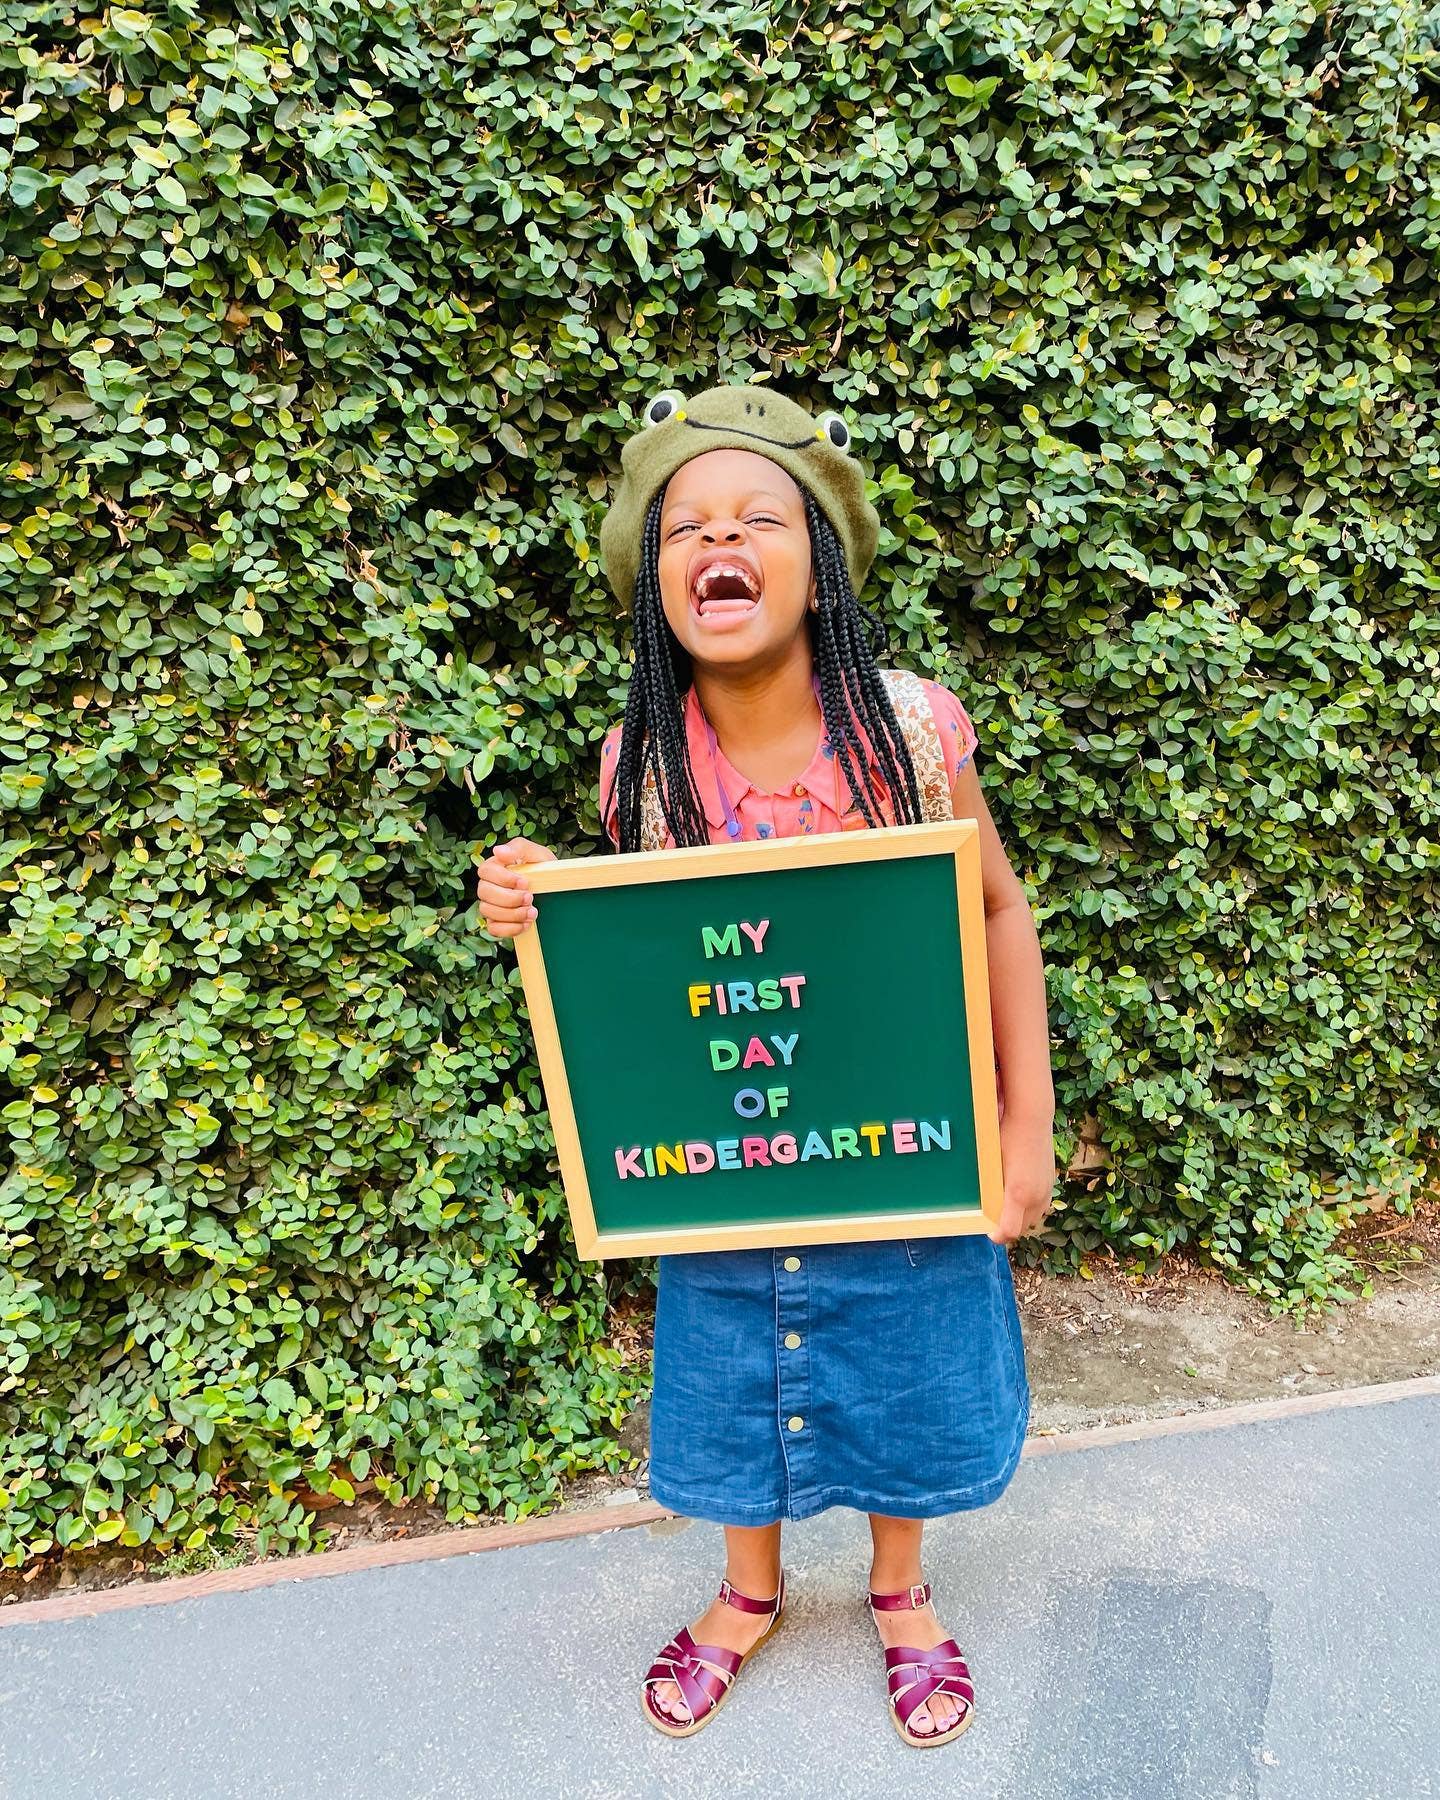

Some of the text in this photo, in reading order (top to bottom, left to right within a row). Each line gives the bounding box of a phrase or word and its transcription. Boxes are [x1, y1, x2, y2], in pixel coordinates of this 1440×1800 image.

[701, 920, 770, 958] MY
[688, 975, 806, 1017] FIRST
[709, 1033, 799, 1071] DAY
[733, 1087, 789, 1118] OF
[614, 1120, 952, 1179] KINDERGARTEN
